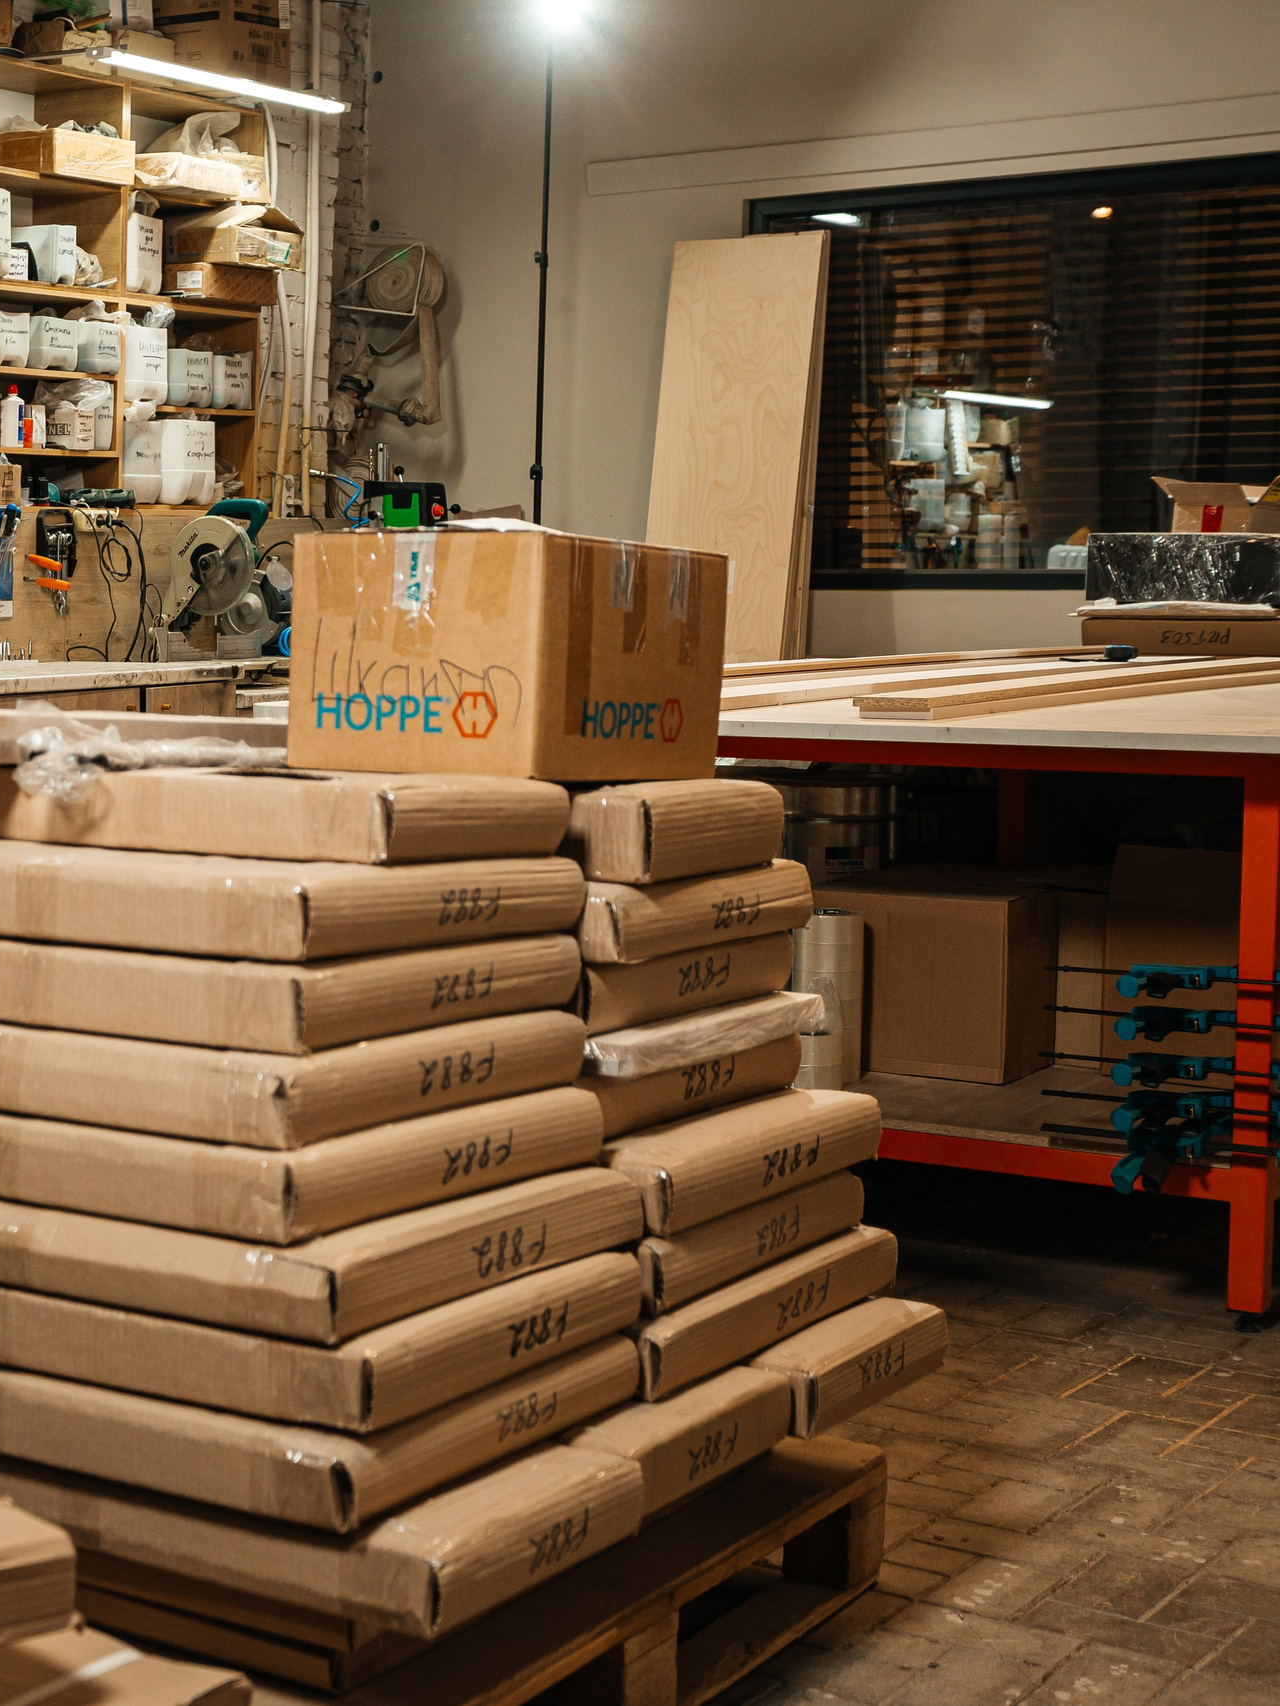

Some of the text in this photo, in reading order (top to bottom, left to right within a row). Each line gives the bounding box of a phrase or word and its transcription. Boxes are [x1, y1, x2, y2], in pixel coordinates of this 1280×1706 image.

[315, 691, 444, 734] HOPPE
[580, 699, 657, 741] HOPPE
[431, 962, 496, 1011] F882
[678, 954, 732, 996] F882
[419, 1042, 496, 1097] F882
[681, 1054, 737, 1100] F882
[443, 1128, 514, 1186] F882
[762, 1135, 821, 1188] F882
[472, 1221, 548, 1278] F882
[507, 1299, 571, 1359] F882
[858, 1339, 907, 1390] F882
[495, 1391, 559, 1444] F882
[687, 1420, 739, 1482] F882
[528, 1505, 590, 1575] F882
